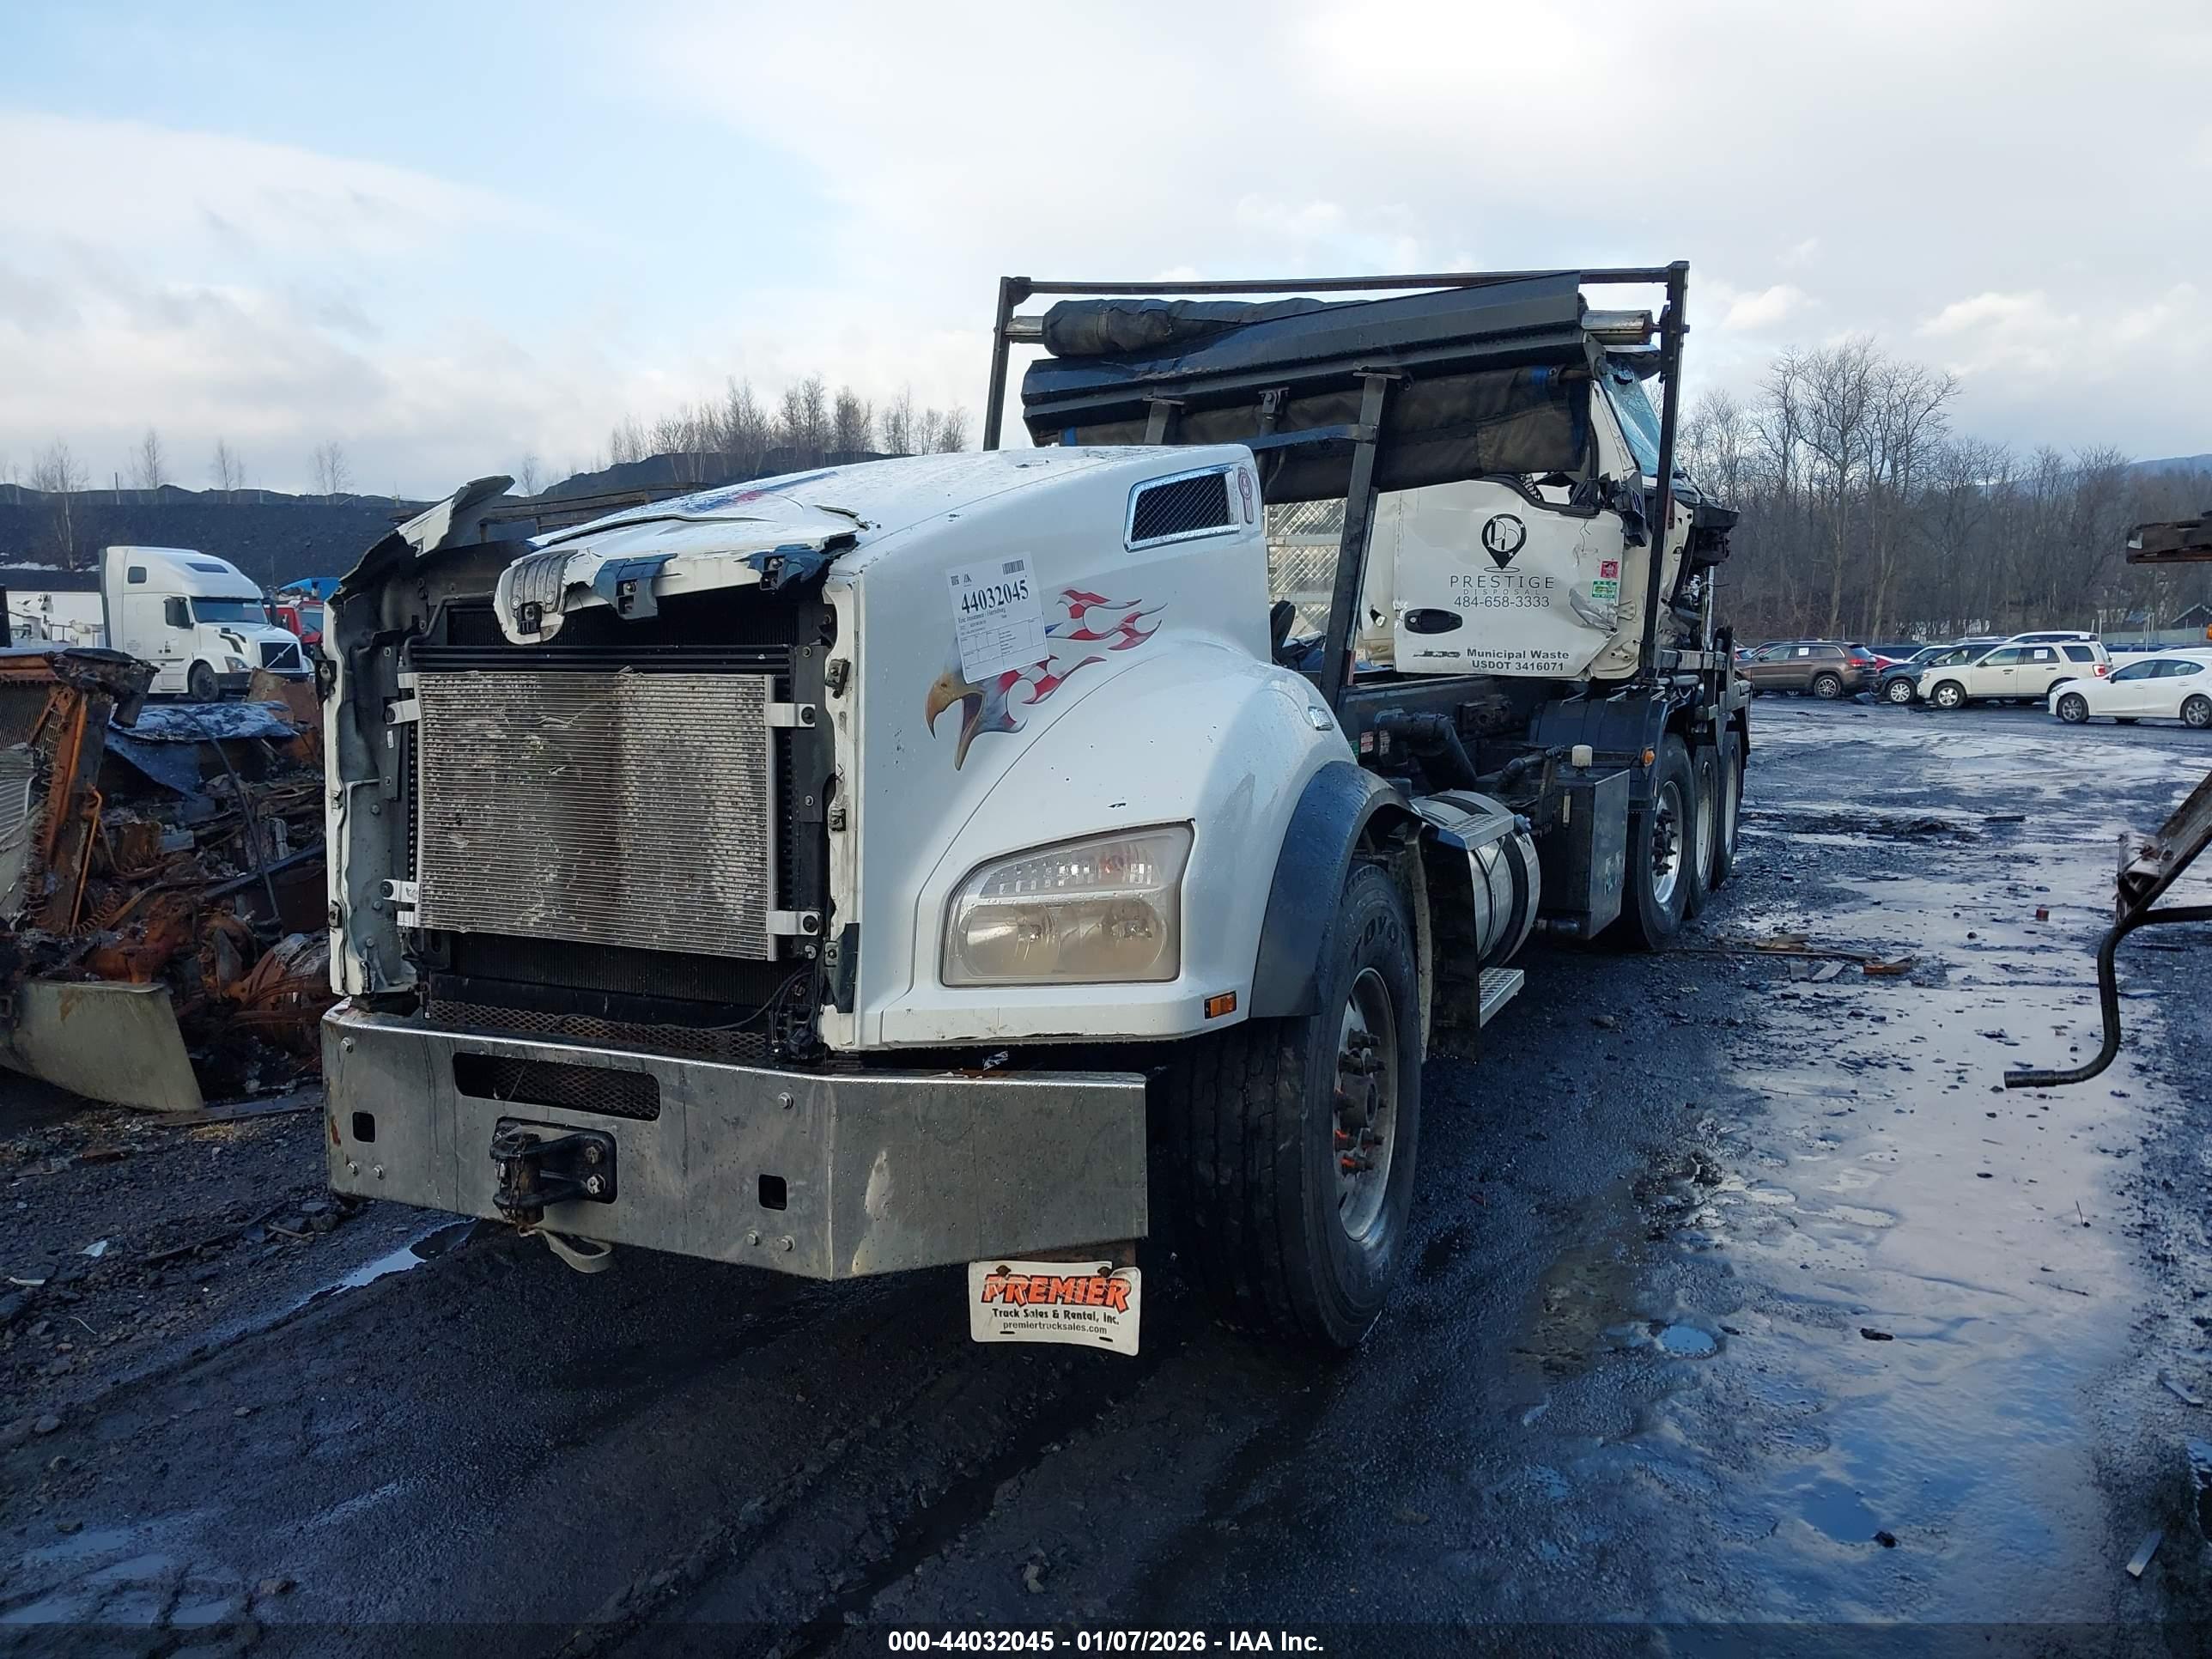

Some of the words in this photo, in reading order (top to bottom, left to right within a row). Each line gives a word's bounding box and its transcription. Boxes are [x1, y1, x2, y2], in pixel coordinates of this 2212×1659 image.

[1449, 575, 1554, 589] PRESTIGE
[962, 580, 1029, 613] 44032045
[1454, 596, 1550, 608] 484-658-3333
[1467, 648, 1526, 659] Municipal
[1530, 650, 1570, 659] Waste
[1472, 660, 1511, 670] USDOT
[1515, 662, 1564, 672] 3416071
[981, 1274, 1132, 1314] PREMIER
[992, 1309, 1020, 1318] Truck
[1023, 1310, 1049, 1319] Sales
[1052, 1310, 1060, 1319] &
[1064, 1310, 1100, 1322] Rental,
[1103, 1312, 1120, 1325] Inc.
[1003, 1321, 1108, 1334] premiertrucksales.com
